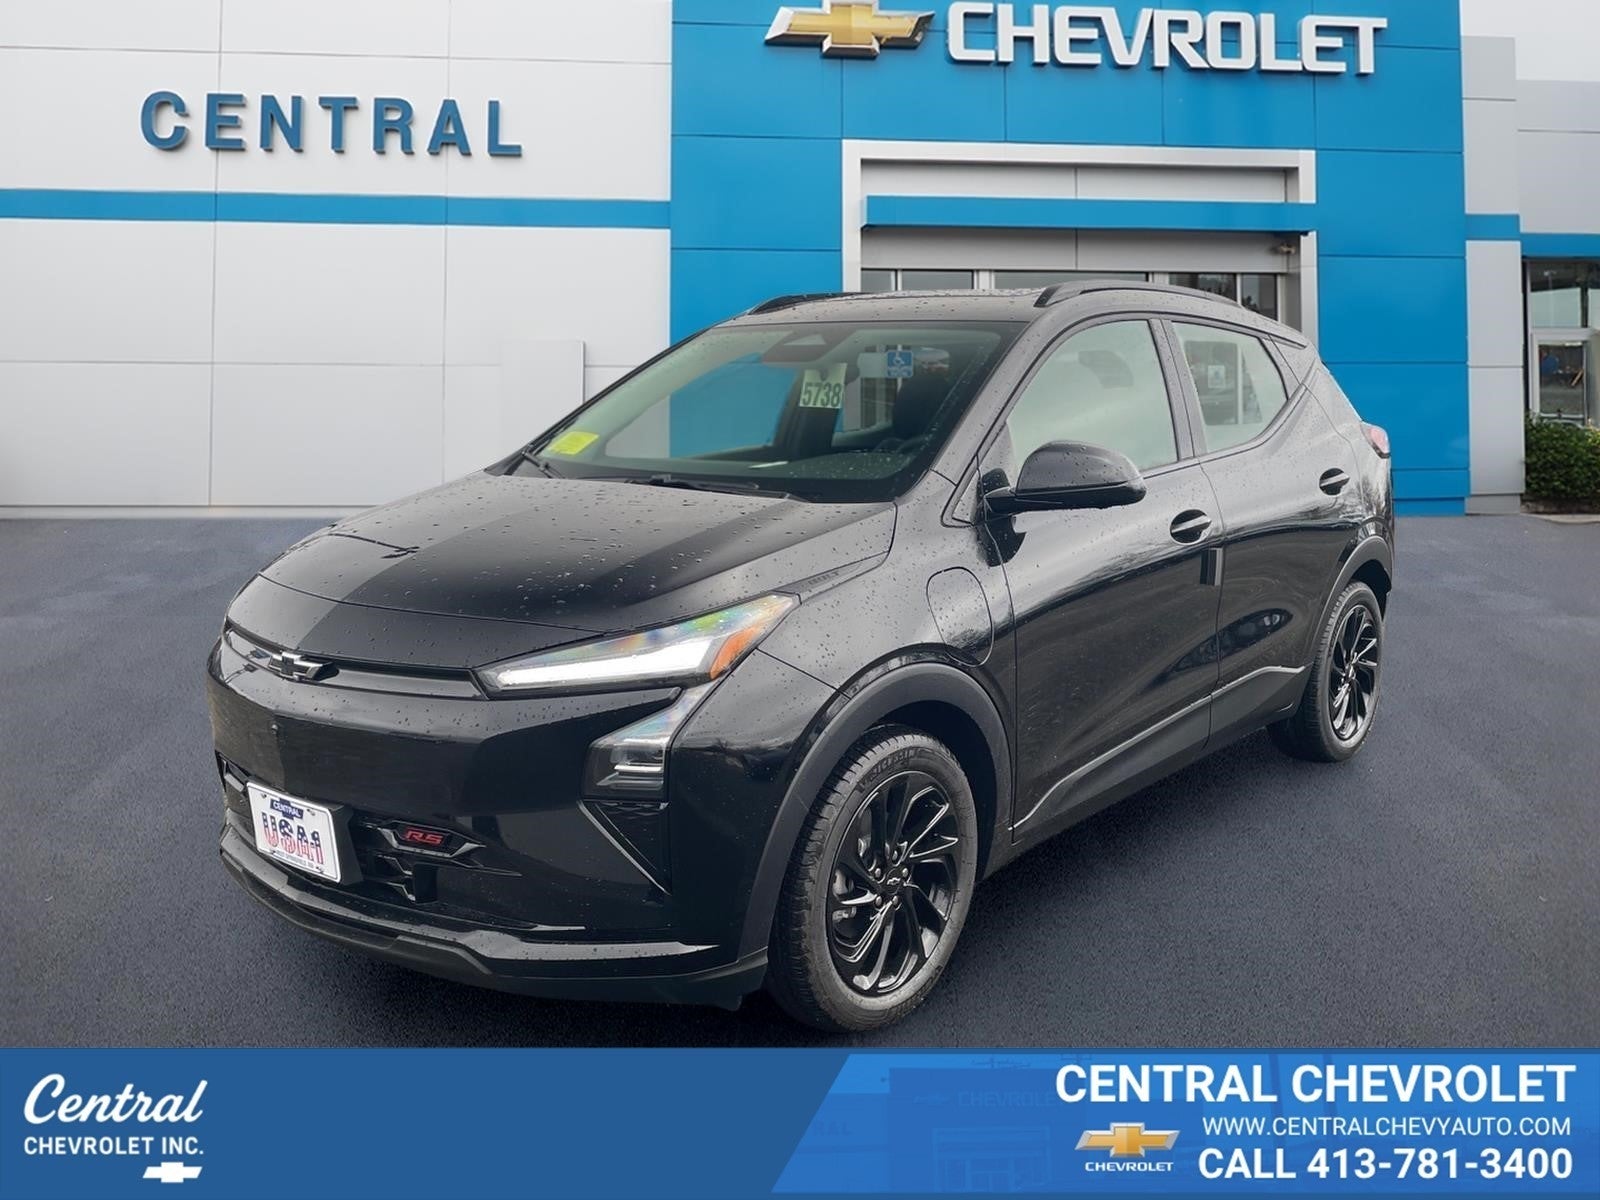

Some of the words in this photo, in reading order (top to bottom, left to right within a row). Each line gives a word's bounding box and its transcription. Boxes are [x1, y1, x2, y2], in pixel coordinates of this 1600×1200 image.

[947, 1, 1388, 75] CHEVROLET
[141, 90, 522, 158] CENTRAL
[802, 382, 842, 407] 5738
[272, 801, 301, 818] CENTRAL
[404, 829, 444, 845] RS
